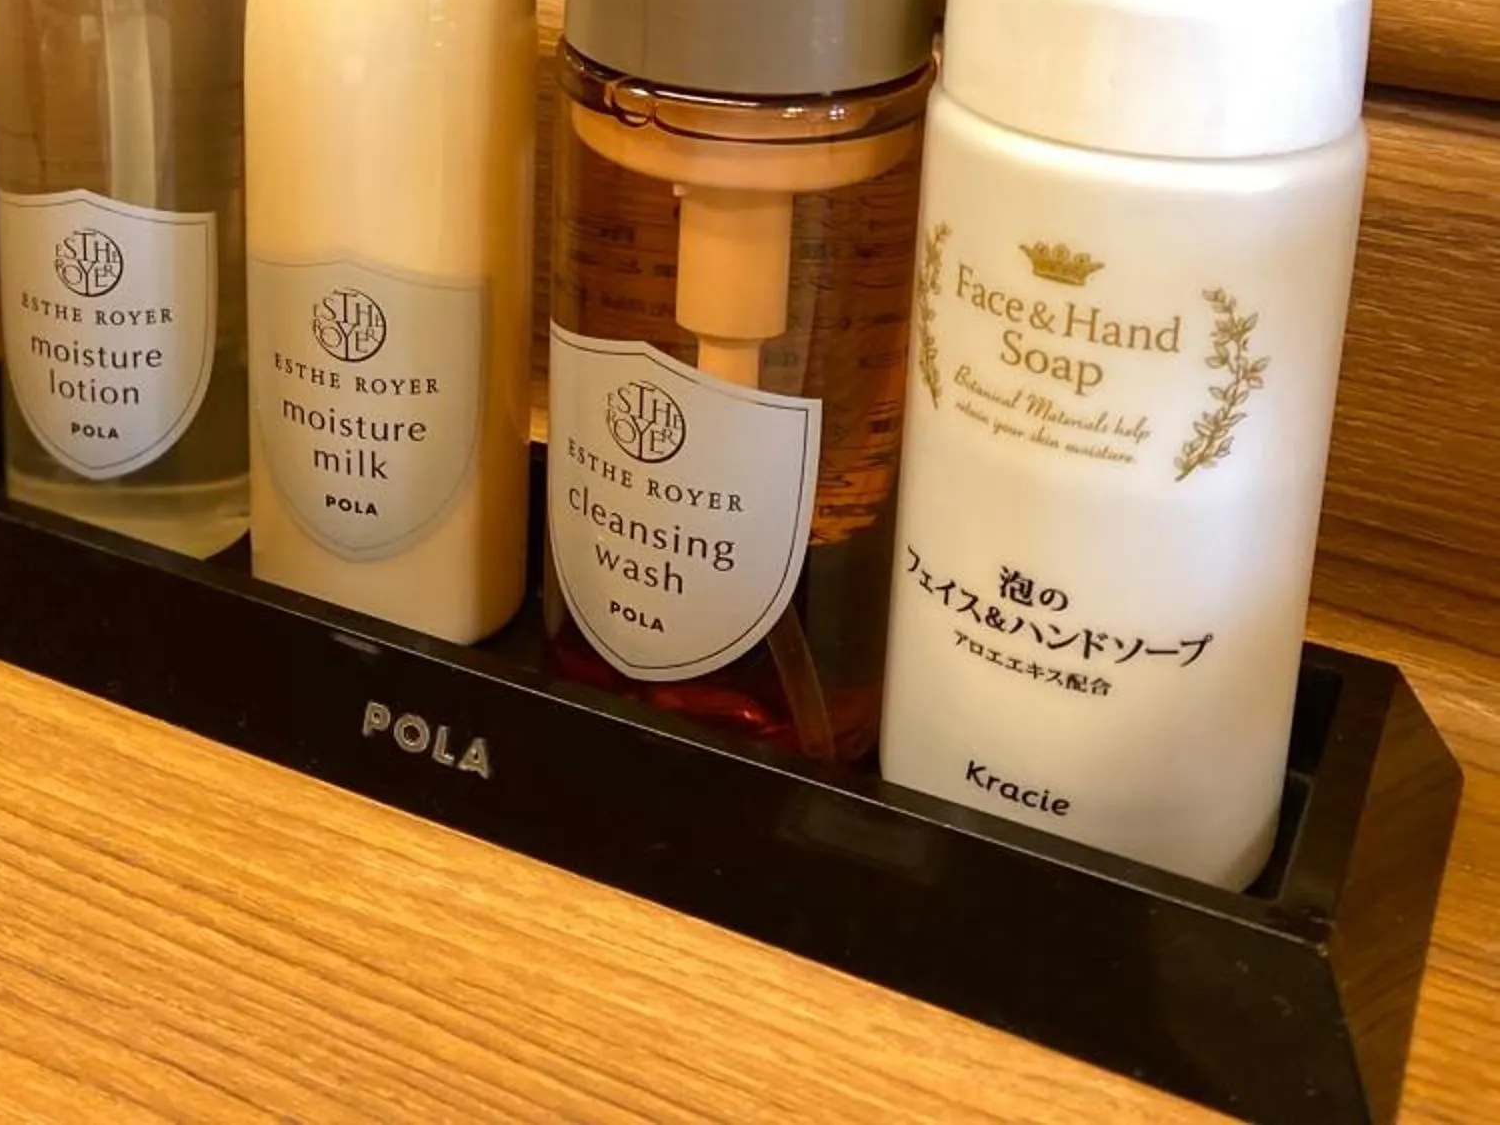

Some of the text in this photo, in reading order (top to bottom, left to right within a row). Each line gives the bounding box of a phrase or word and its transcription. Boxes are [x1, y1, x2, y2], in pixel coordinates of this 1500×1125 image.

[21, 292, 174, 327] ESTHE ROYER
[31, 335, 163, 369] moisture
[274, 352, 440, 396] ESTHE ROYER
[1000, 329, 1104, 396] Soap
[50, 369, 140, 405] lotion
[71, 422, 120, 440] POLA
[282, 399, 427, 442] moisture
[313, 449, 388, 480] milk
[568, 439, 745, 512] ESTHE ROYER
[325, 494, 379, 516] POLA
[569, 486, 736, 571] cleansing
[595, 543, 684, 595] wash
[998, 565, 1070, 612] 泡の
[610, 600, 665, 633] POLA
[954, 630, 1113, 697] アロエエキス配合
[362, 700, 491, 779] POLA
[964, 760, 1071, 816] Kracie
